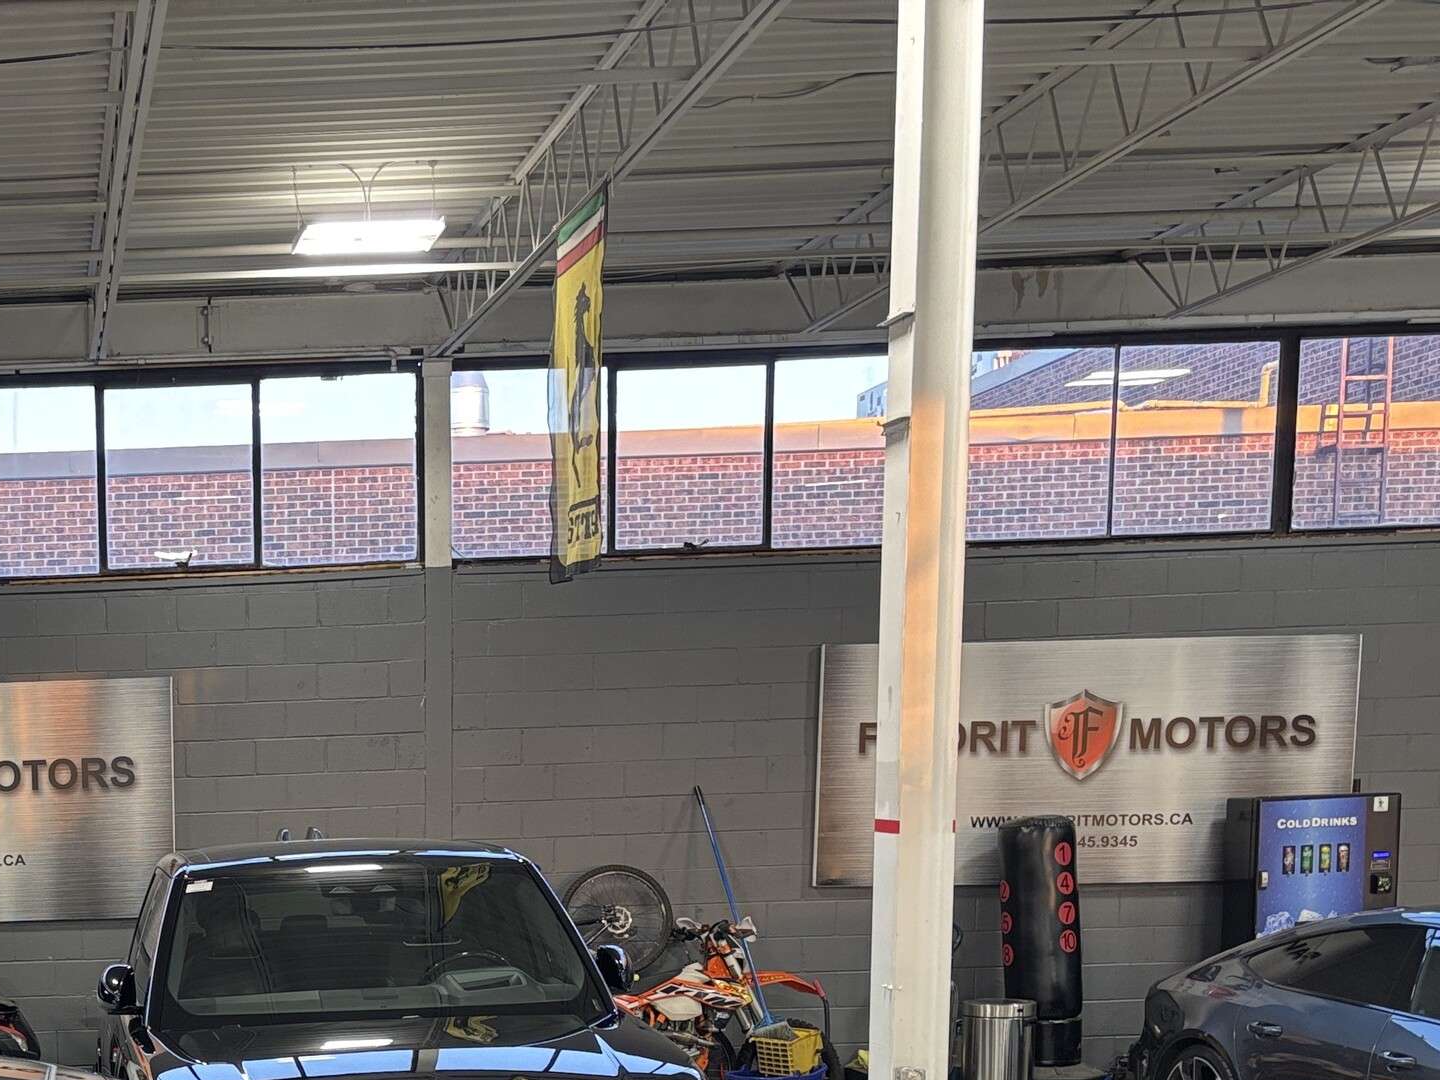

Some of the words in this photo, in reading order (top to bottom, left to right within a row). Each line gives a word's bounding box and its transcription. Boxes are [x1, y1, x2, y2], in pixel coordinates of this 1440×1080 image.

[858, 720, 1036, 754] FRIT
[1129, 714, 1317, 751] MOTORS
[1078, 835, 1138, 848] 45.9345
